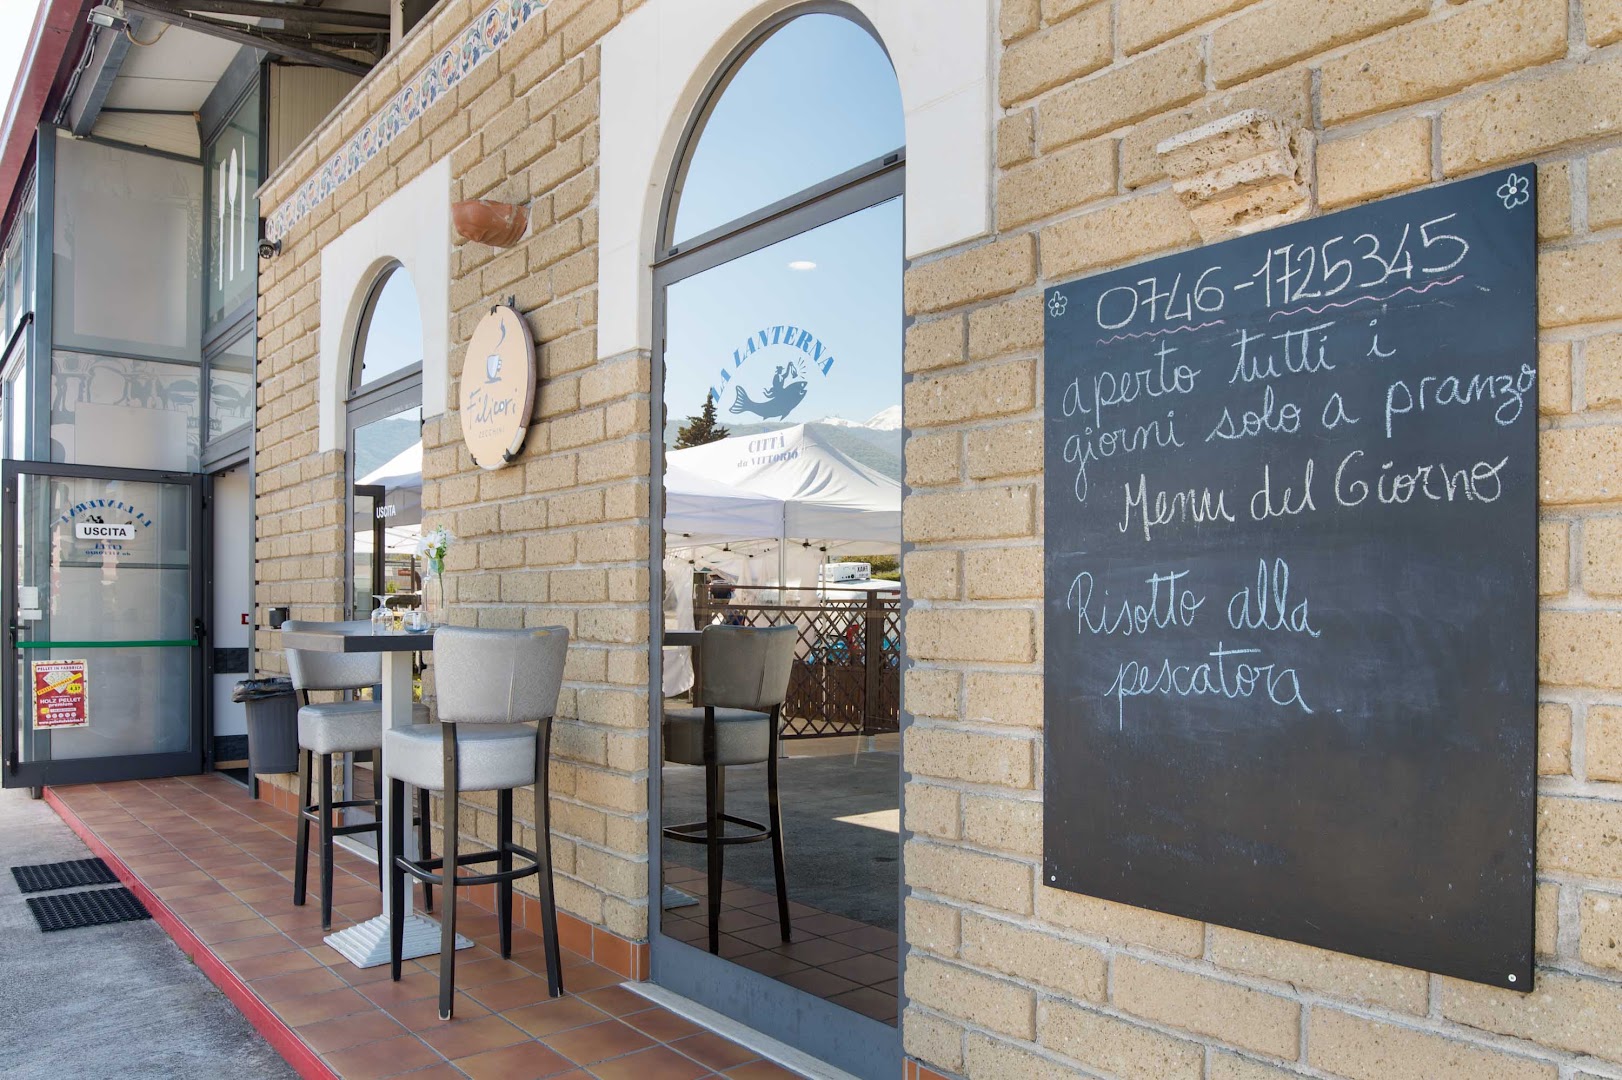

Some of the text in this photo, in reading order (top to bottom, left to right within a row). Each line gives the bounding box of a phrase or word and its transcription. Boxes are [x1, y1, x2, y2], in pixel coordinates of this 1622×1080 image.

[711, 324, 835, 404] LA LANTERNA
[1062, 318, 1397, 428] aperto tutti i
[751, 448, 799, 465] VITTORIO
[1062, 363, 1536, 501] giorni solo a pranzo
[83, 526, 127, 537] USCITA
[376, 504, 397, 519] USCITA
[1118, 450, 1509, 541] Menu del Giorno
[1067, 557, 1321, 637] Risotto alla
[1104, 641, 1314, 731] pescatora
